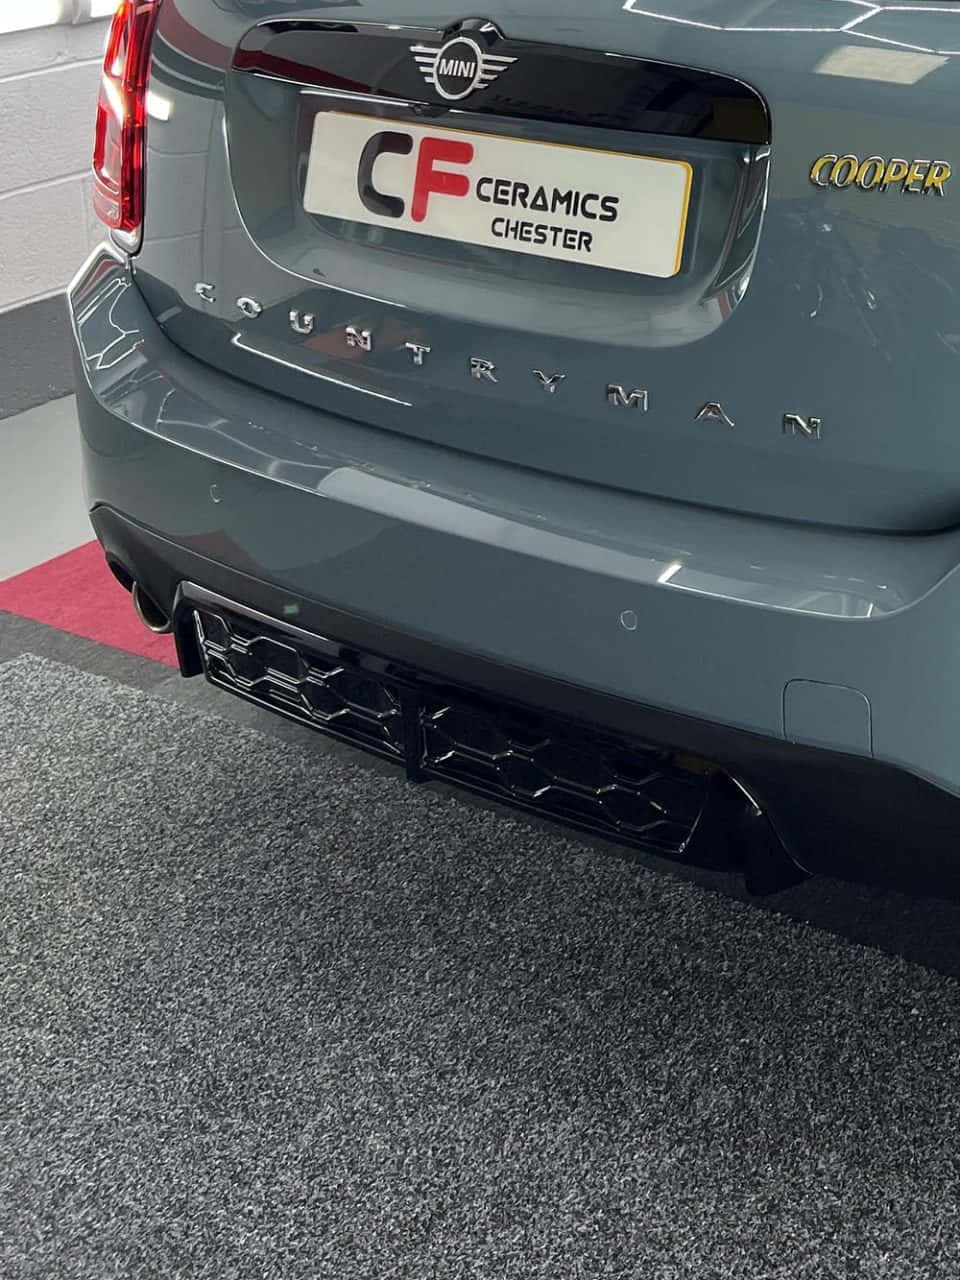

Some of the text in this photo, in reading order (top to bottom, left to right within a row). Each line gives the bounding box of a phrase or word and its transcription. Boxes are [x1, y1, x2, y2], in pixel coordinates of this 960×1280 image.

[439, 58, 476, 78] MINI
[357, 131, 474, 223] CF
[809, 154, 951, 197] COOPER
[476, 177, 619, 222] CERAMICS
[491, 218, 593, 252] CHESTER
[194, 281, 821, 440] COUNTRYMAN
